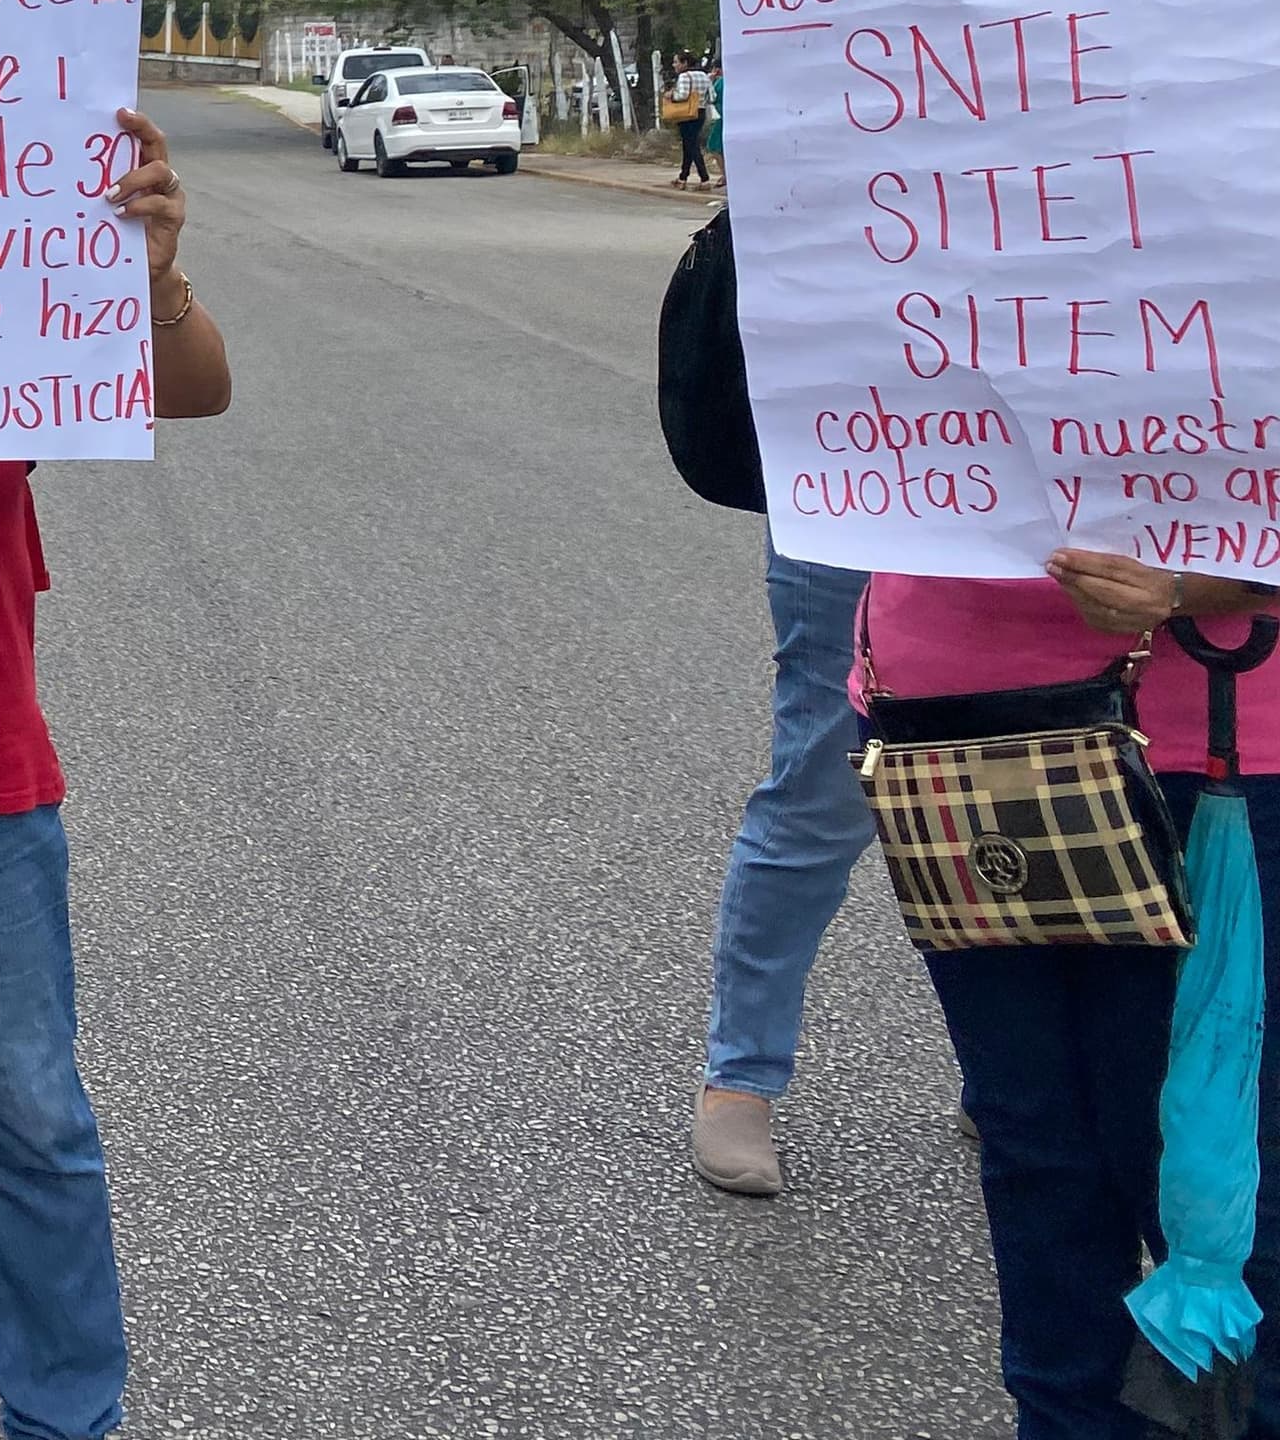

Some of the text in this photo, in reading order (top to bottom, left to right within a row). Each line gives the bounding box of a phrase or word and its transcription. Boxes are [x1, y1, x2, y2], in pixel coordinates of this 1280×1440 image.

[843, 10, 1128, 134] SNTE
[75, 130, 137, 199] 30
[863, 150, 1155, 265] SITET
[39, 277, 142, 342] hizo
[895, 290, 1226, 399] SITEM
[814, 386, 1280, 457] cobran nuestr
[793, 451, 1000, 519] cuotas
[1053, 475, 1082, 532] y
[1120, 471, 1199, 505] no
